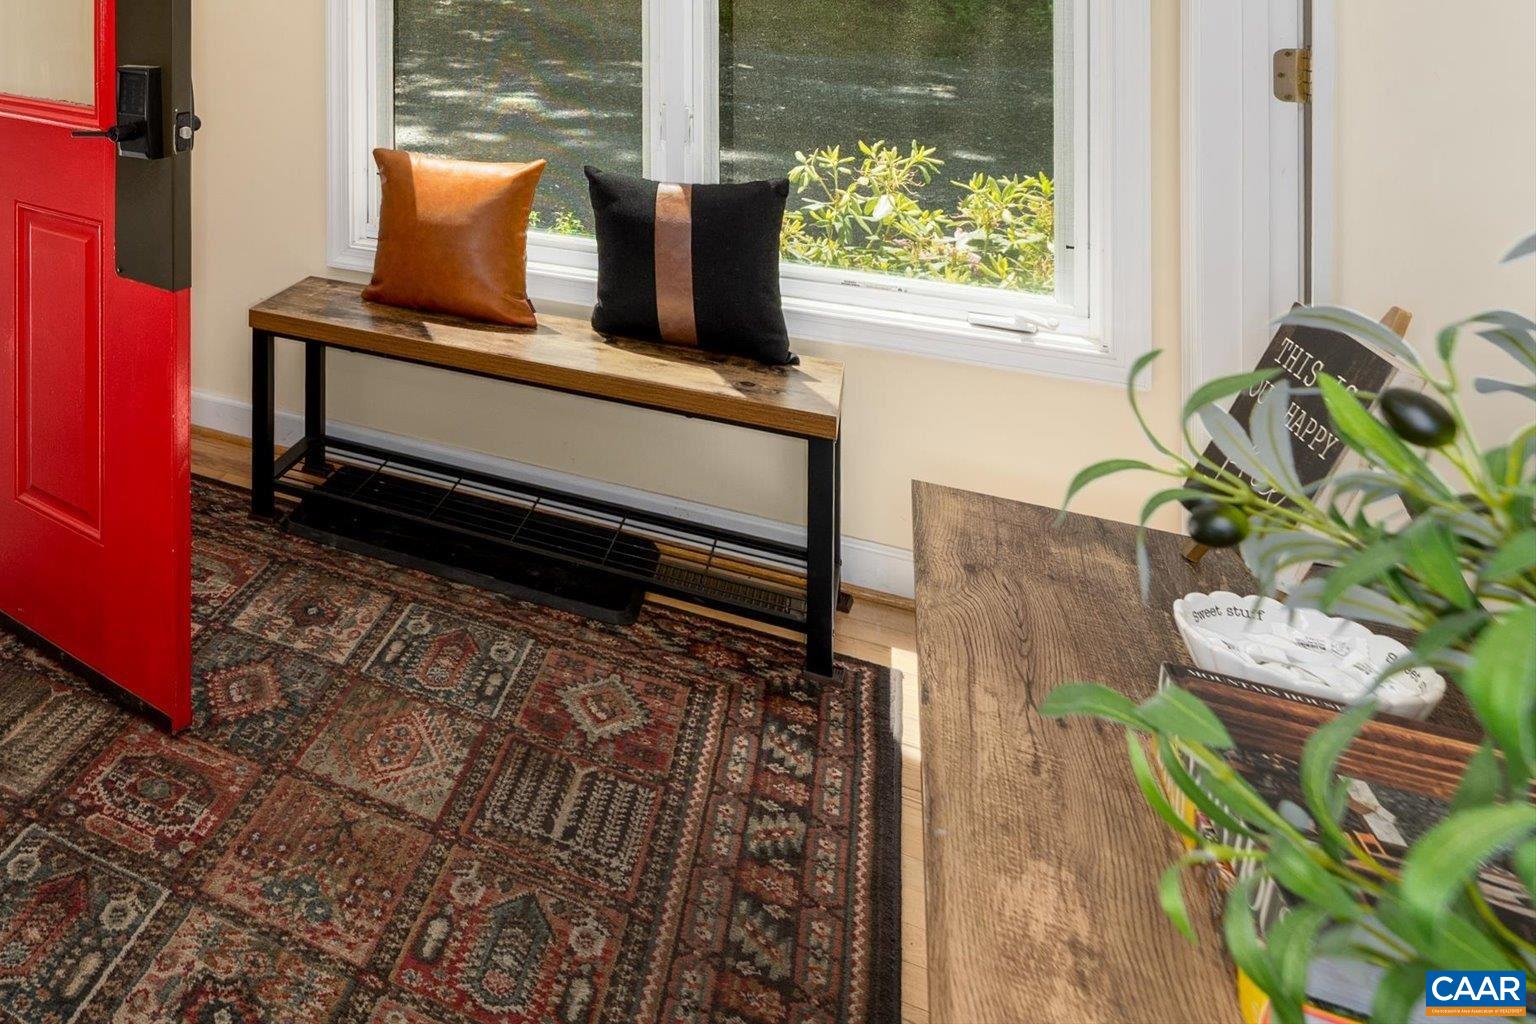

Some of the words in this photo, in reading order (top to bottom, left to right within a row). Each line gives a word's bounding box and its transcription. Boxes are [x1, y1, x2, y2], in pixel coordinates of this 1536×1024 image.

[1274, 337, 1325, 388] THIS
[1284, 401, 1340, 461] HAPPY
[1191, 605, 1224, 624] sweet
[1186, 668, 1281, 697] MOUNTAIN
